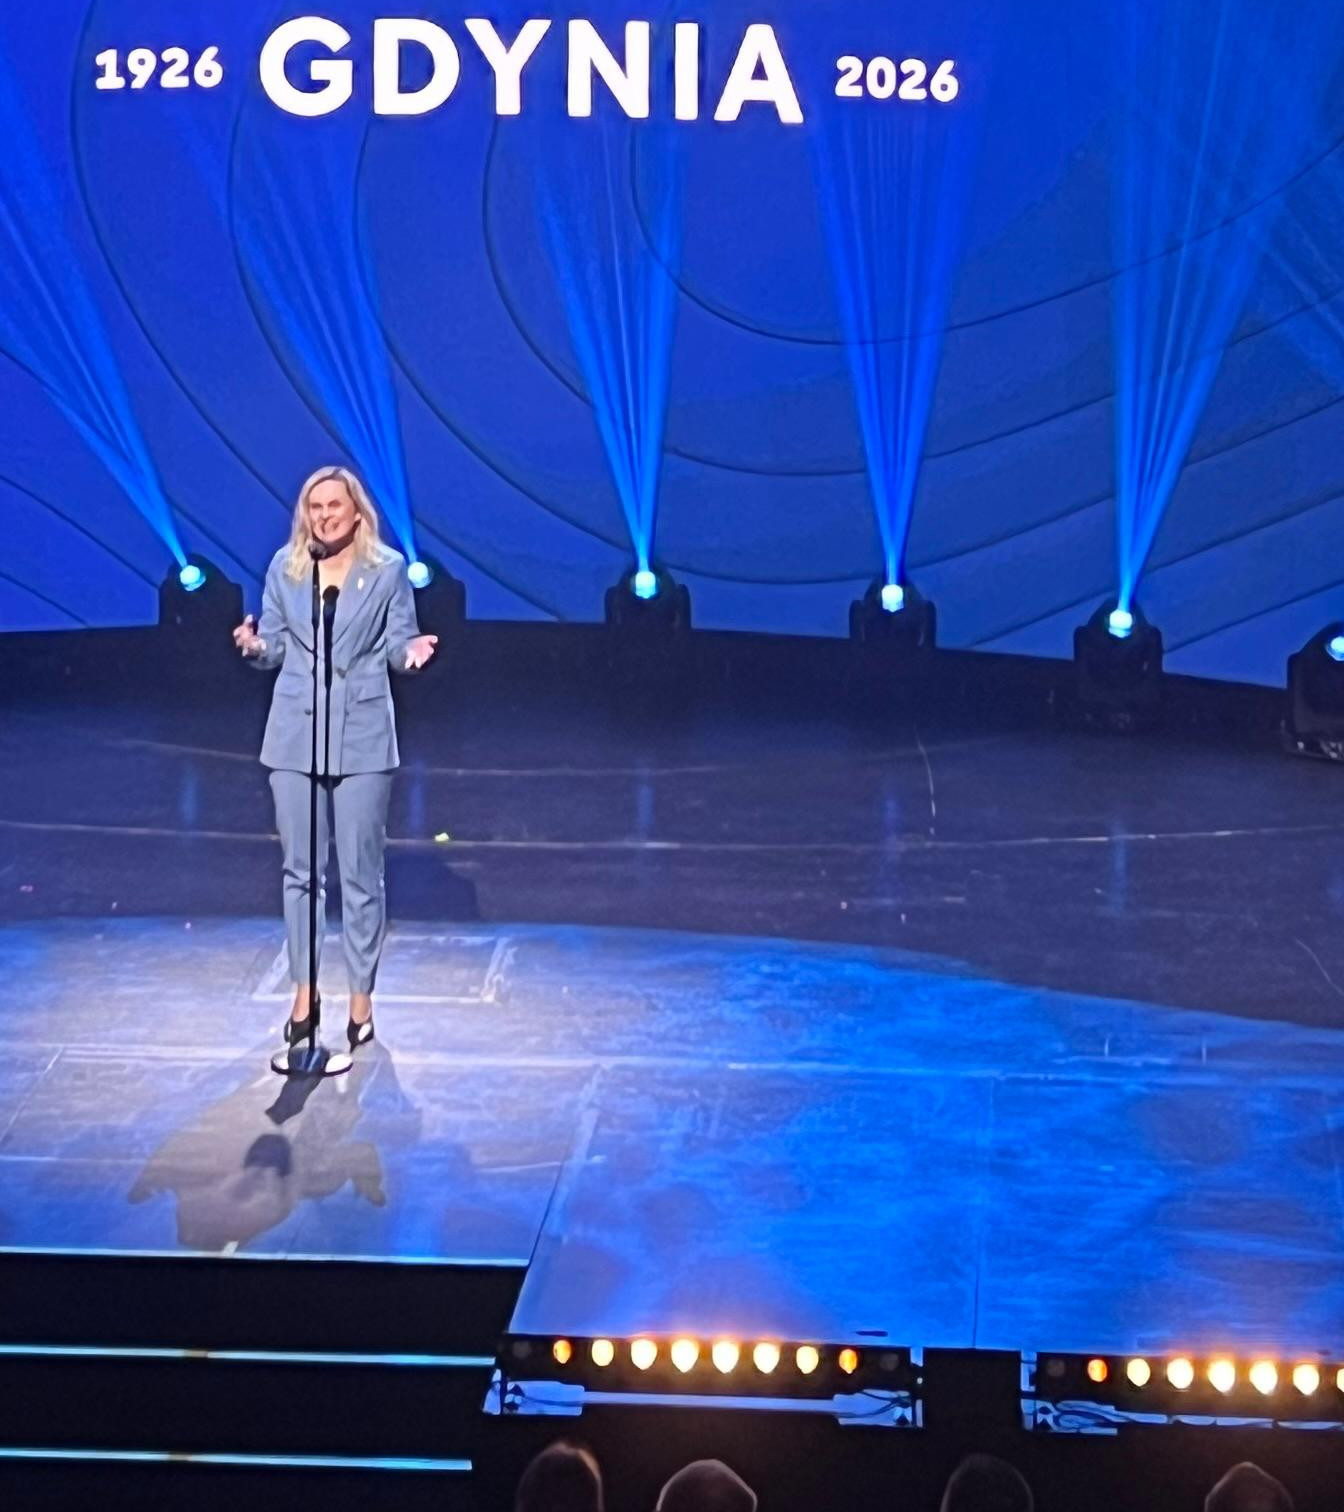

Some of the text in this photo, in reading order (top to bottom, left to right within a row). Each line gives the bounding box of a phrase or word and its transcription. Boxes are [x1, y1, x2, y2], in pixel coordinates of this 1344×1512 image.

[94, 14, 960, 126] 1926 GDYNIA 2026
